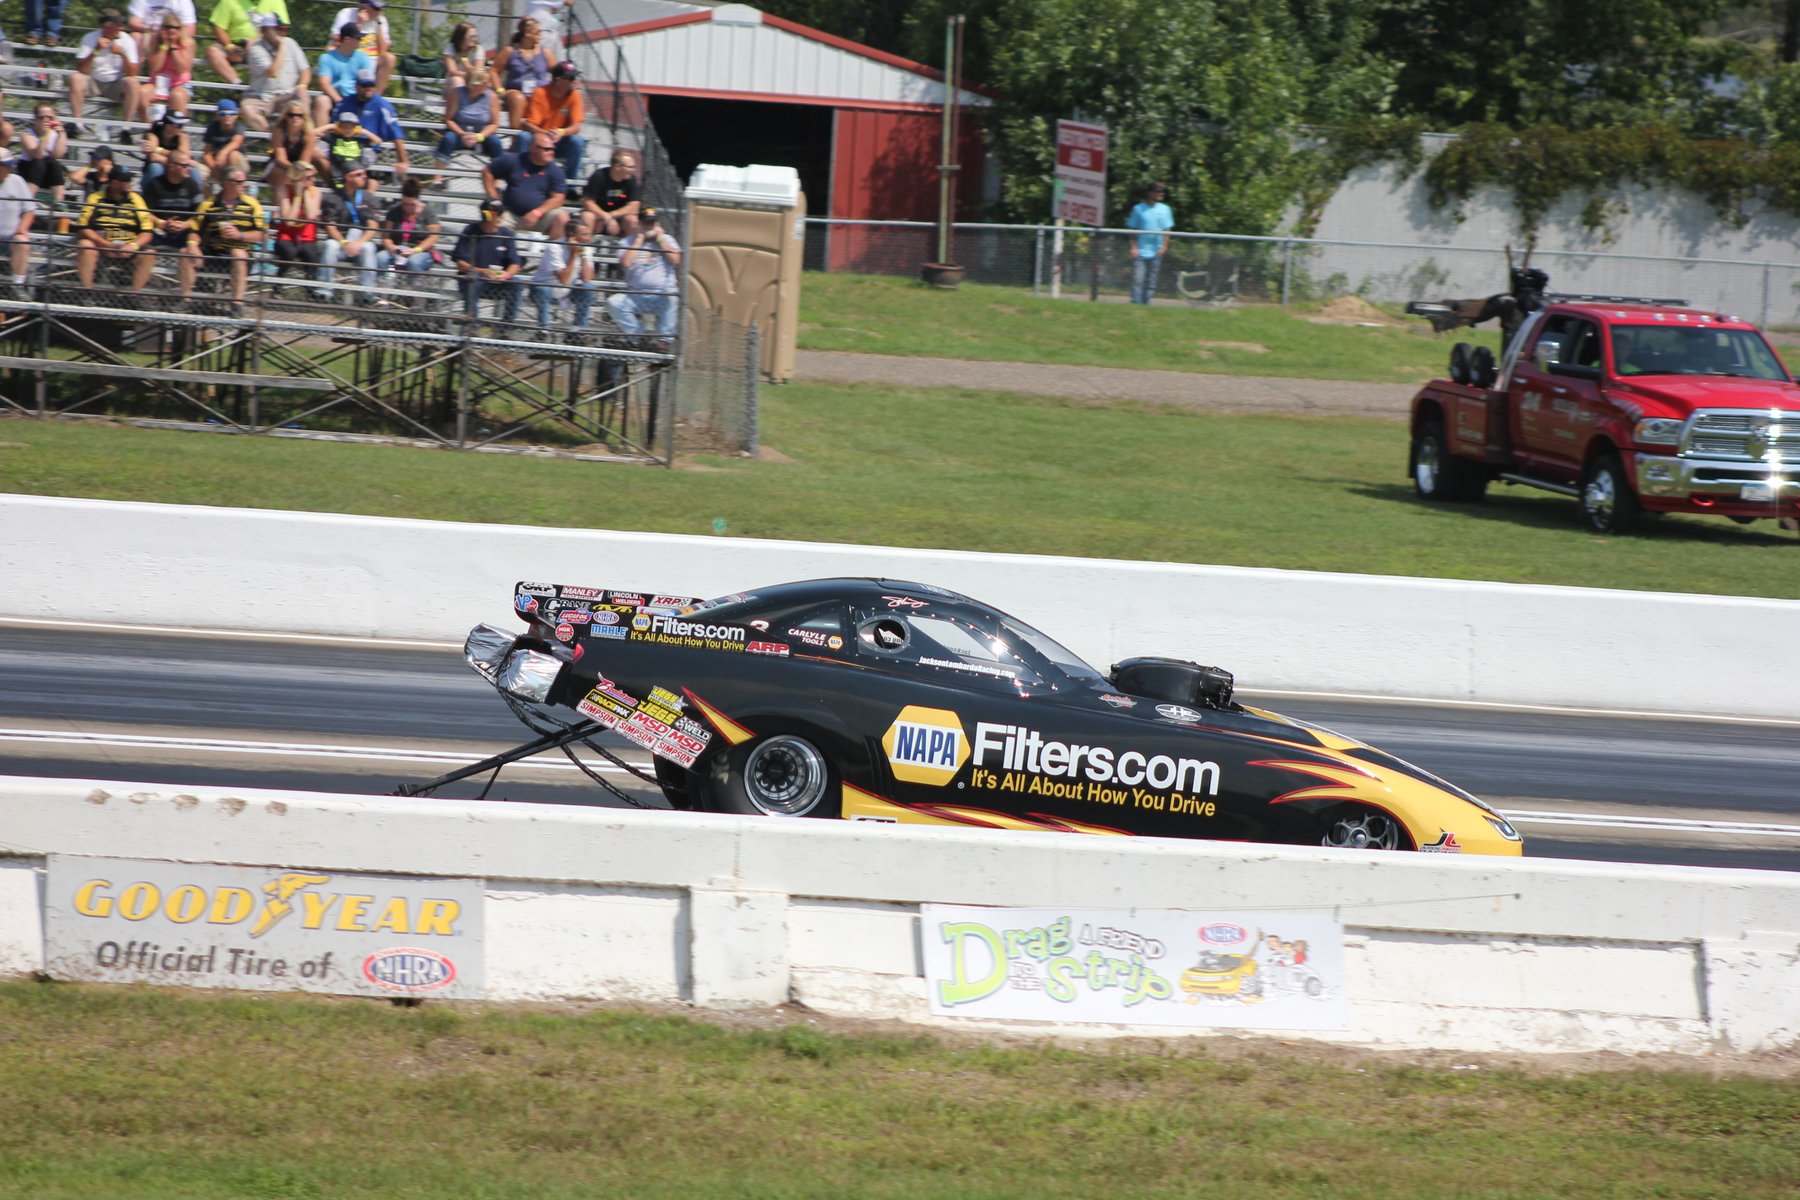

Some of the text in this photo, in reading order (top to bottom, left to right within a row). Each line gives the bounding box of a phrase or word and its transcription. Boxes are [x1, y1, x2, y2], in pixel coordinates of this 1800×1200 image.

[515, 594, 532, 611] VP
[563, 586, 598, 597] MANLEY
[609, 591, 639, 599] LINCOLN
[654, 596, 682, 605] XRP
[591, 625, 626, 636] MAHLE
[635, 618, 648, 626] NAPA
[652, 615, 745, 641] Filters.com
[630, 631, 642, 641] It's
[644, 632, 656, 642] All
[657, 634, 683, 645] About
[684, 636, 704, 647] How
[705, 638, 721, 649] You
[722, 640, 745, 651] Drive
[788, 628, 826, 640] CARLYLE
[802, 637, 824, 646] TOOLS
[746, 641, 789, 653] ARP
[580, 701, 616, 724] SIMPSON
[596, 694, 630, 718] RACEPAK
[637, 701, 678, 725] JEGS
[619, 721, 655, 744] SIMPSON
[634, 712, 669, 734] MSD
[684, 722, 710, 741] WELD
[657, 741, 693, 763] SIMPSON
[668, 730, 704, 752] MSD
[896, 725, 956, 767] NAPA
[972, 721, 1221, 796] Filters.com
[971, 768, 1216, 817] It's All About How You Drive
[97, 941, 334, 979] Official Tire of
[375, 955, 444, 985] NHRA
[940, 915, 1167, 1008] Drag A FRIEND
[1043, 950, 1173, 1008] Strip
